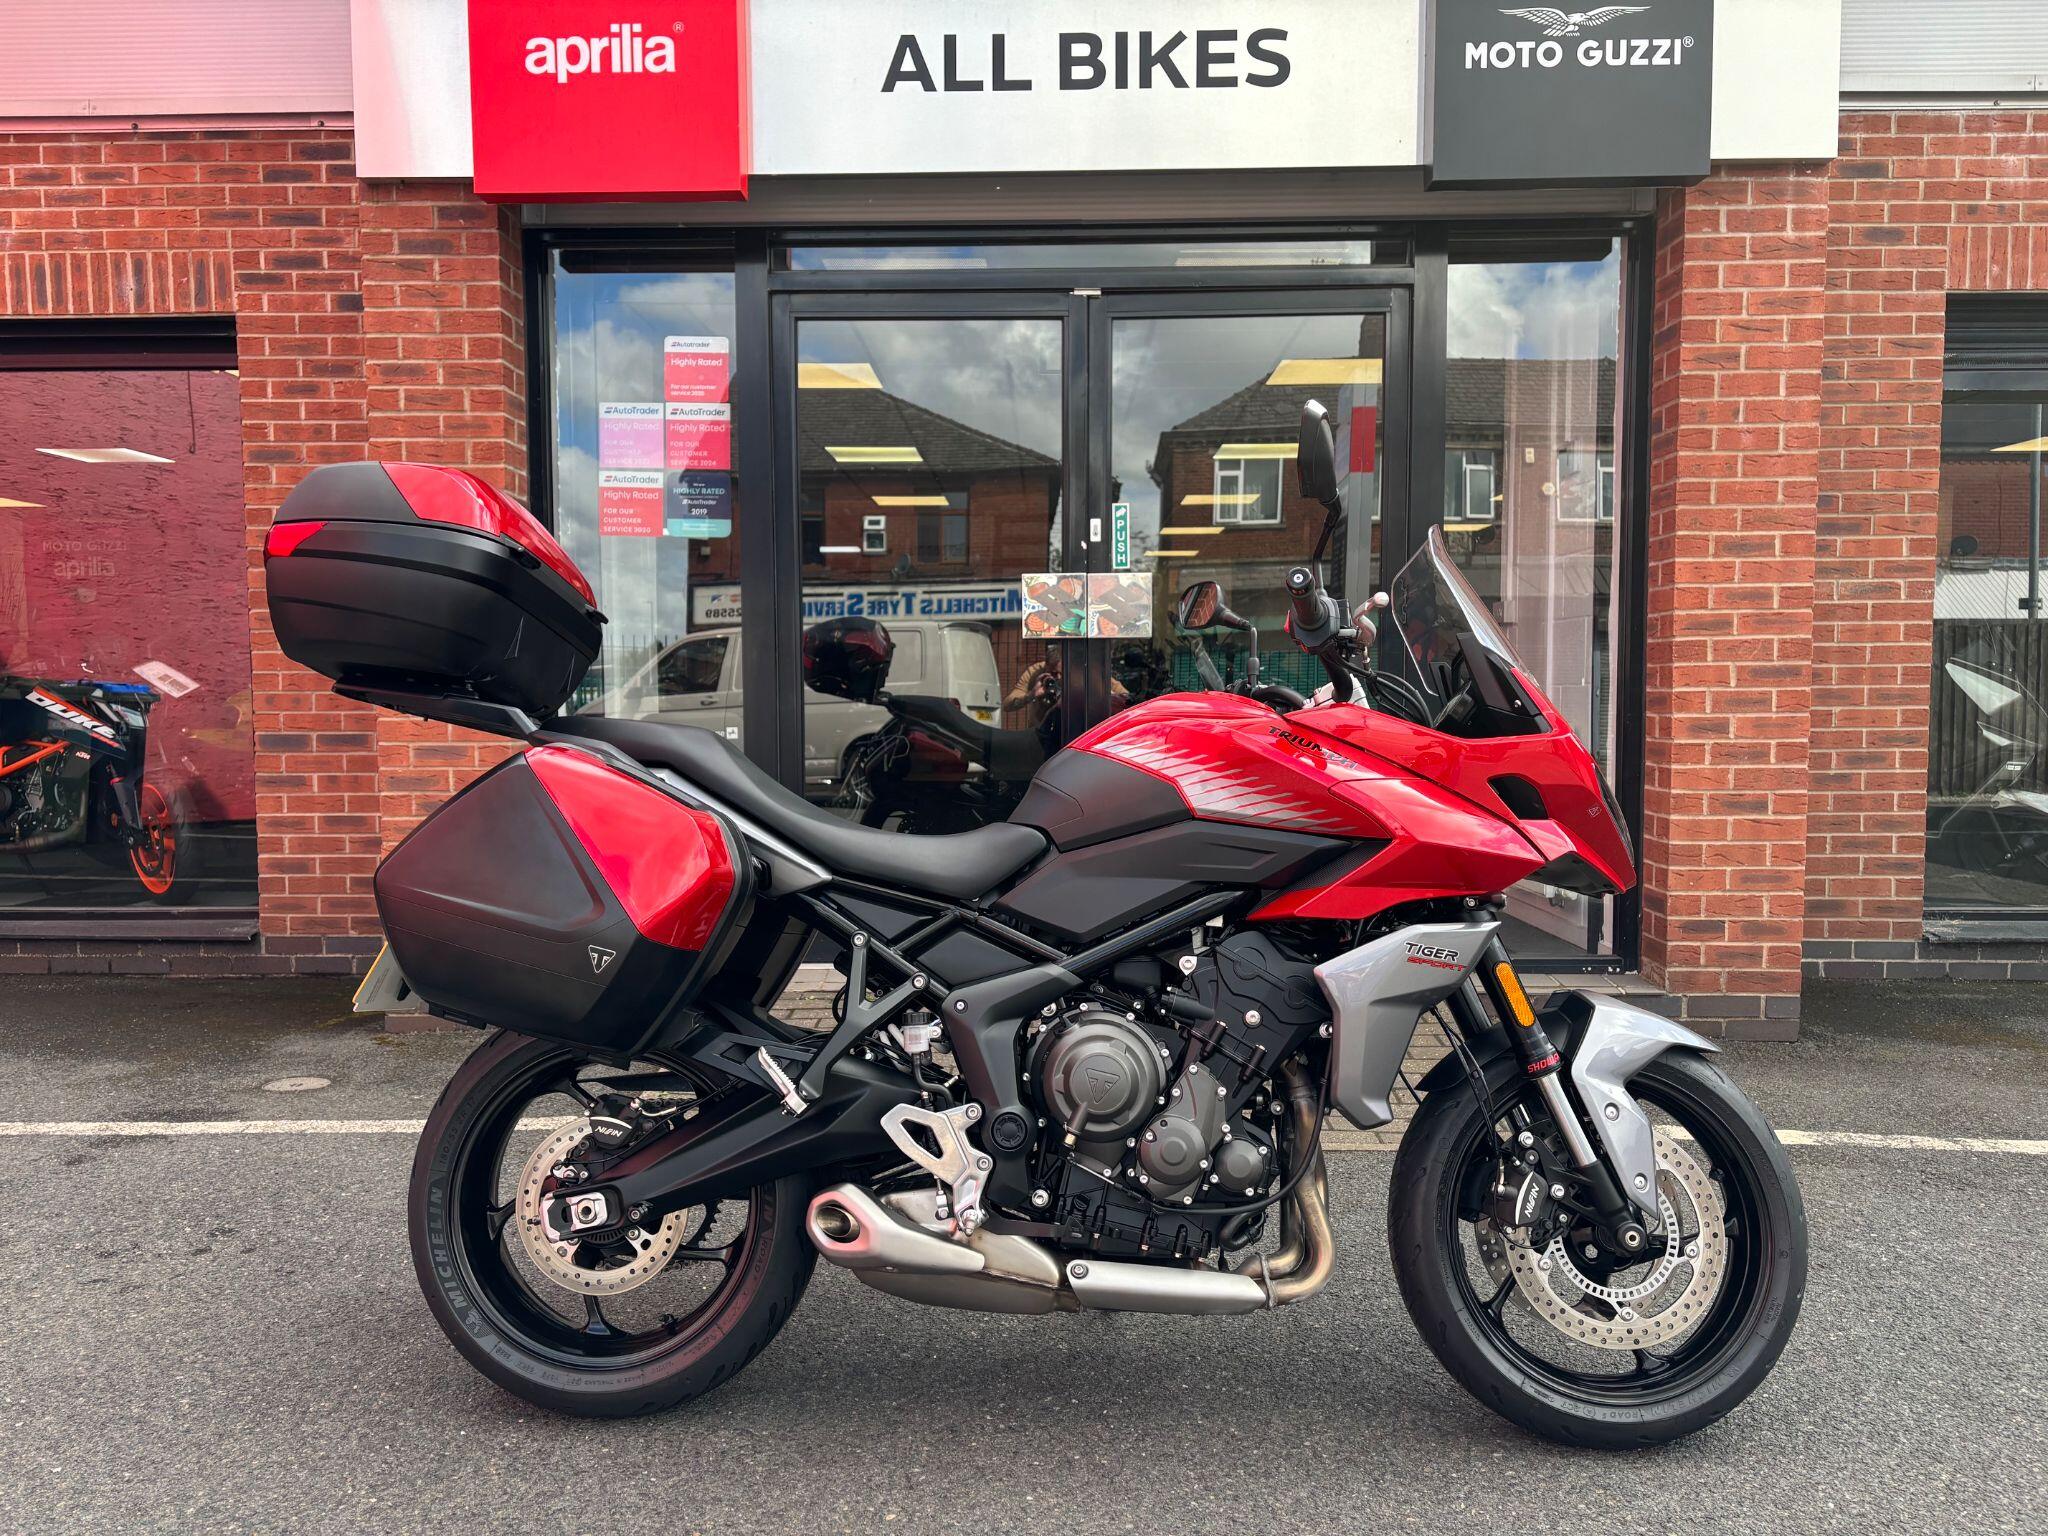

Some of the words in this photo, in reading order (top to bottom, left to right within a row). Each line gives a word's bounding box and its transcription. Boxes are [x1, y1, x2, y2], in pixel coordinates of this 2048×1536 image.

[1465, 39, 1563, 69] MOTO
[881, 34, 1032, 92] ALL
[1058, 28, 1291, 90] BIKES
[671, 358, 697, 368] Highly
[698, 358, 723, 367] Rated
[612, 406, 659, 415] AutoTrader
[679, 408, 726, 416] AutoTrader
[670, 424, 697, 433] Highly
[699, 424, 726, 432] Rated
[670, 440, 684, 448] FOR
[612, 475, 659, 483] AutoTrader
[603, 490, 631, 500] Highly
[632, 490, 659, 500] Rated
[672, 487, 700, 495] HIGHLY
[701, 487, 726, 495] RATED
[1117, 520, 1126, 564] PUSH
[25, 690, 116, 739] DUKE
[75, 751, 91, 760] KTM
[1404, 941, 1459, 962] TIGER
[1527, 1051, 1560, 1073] SHOWA
[430, 1186, 468, 1309] MICHELIN
[1609, 1407, 1639, 1422] ROAD
